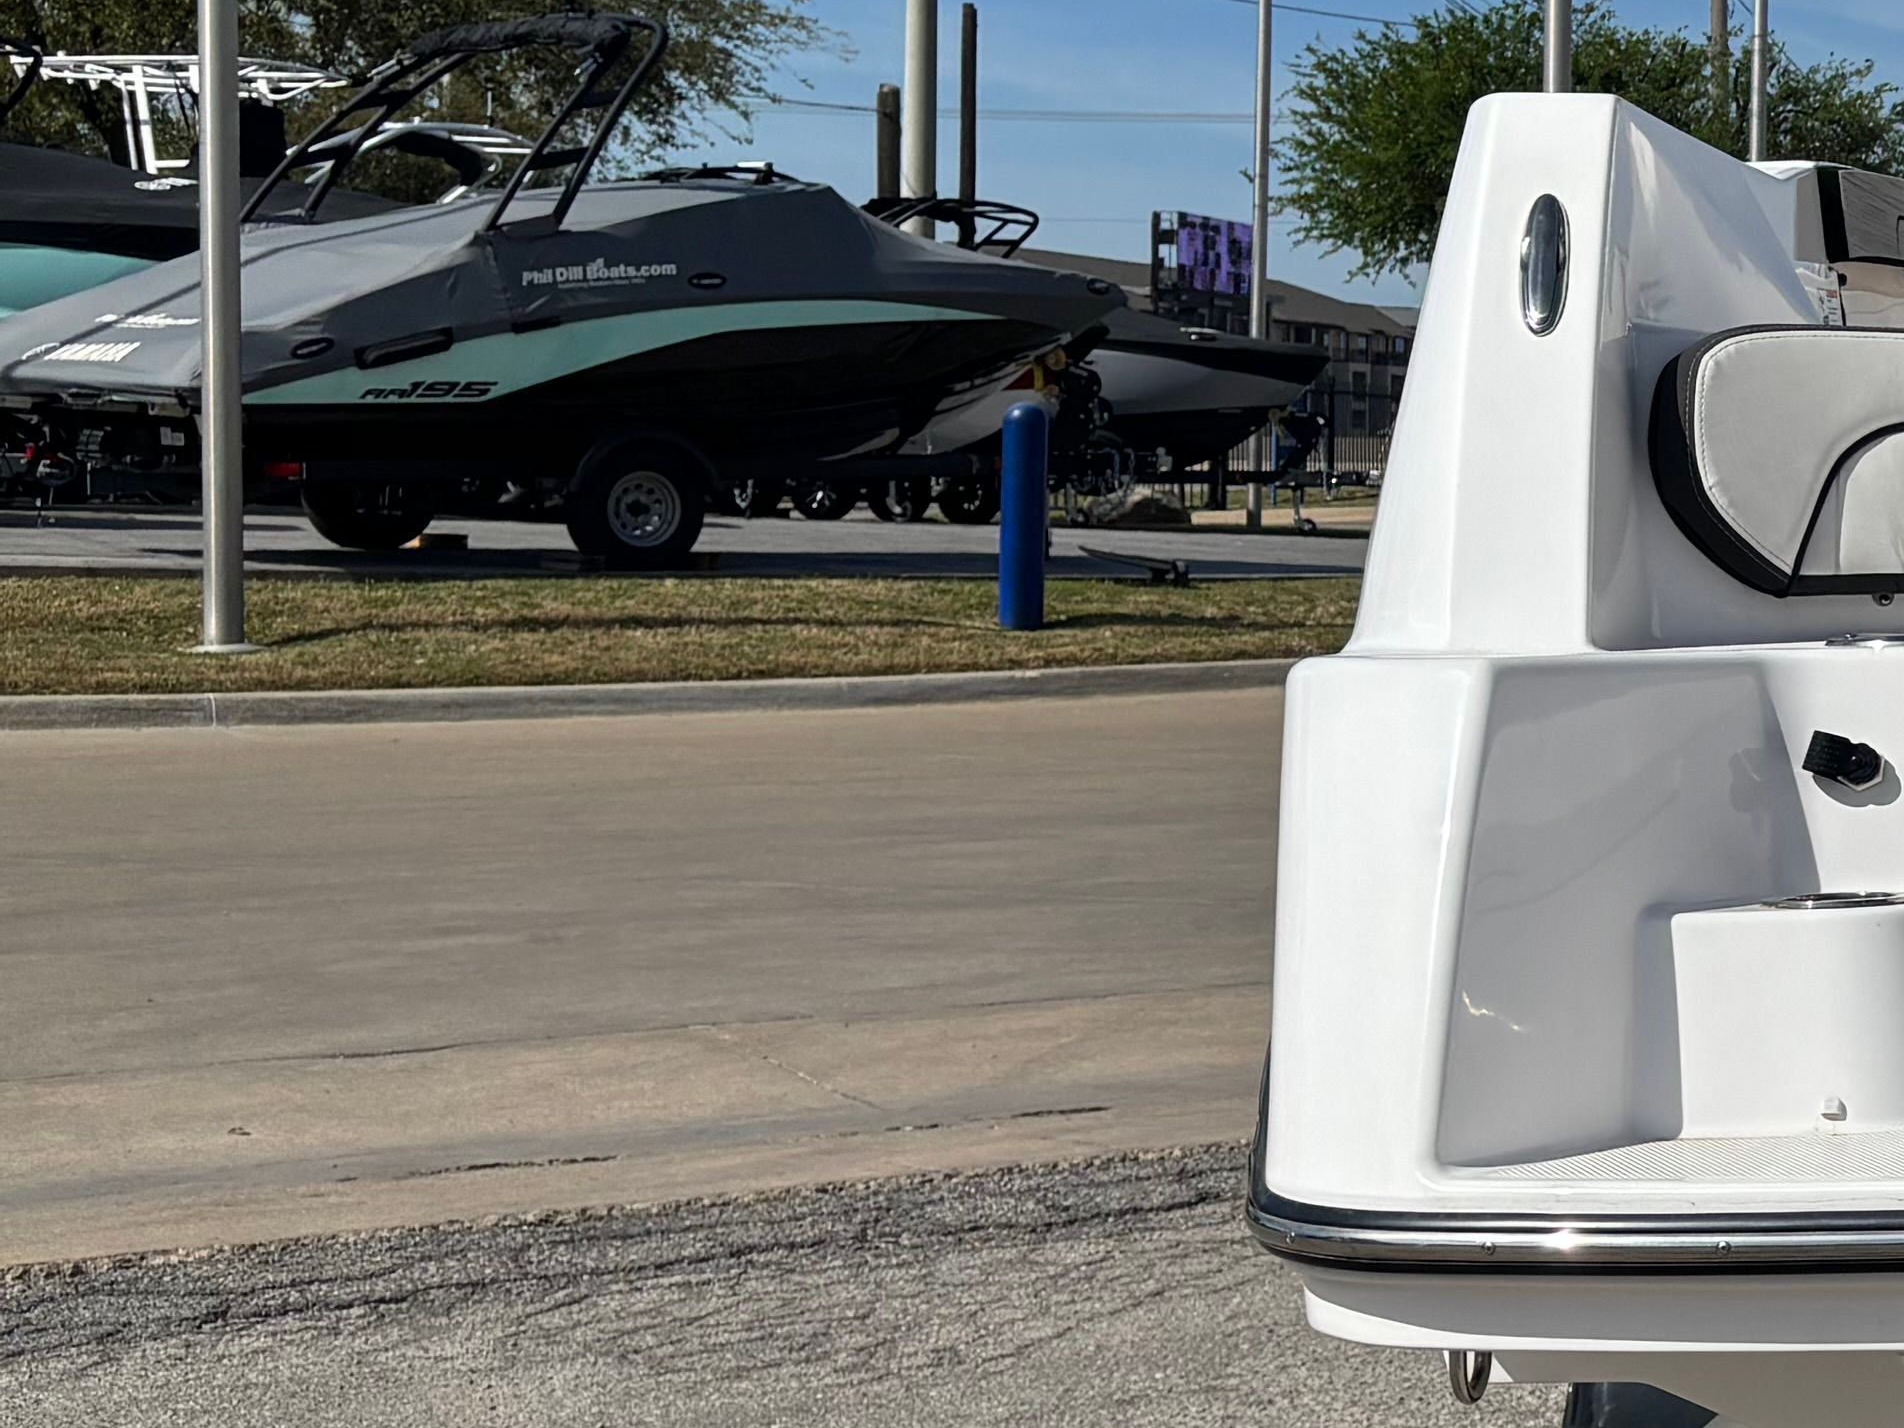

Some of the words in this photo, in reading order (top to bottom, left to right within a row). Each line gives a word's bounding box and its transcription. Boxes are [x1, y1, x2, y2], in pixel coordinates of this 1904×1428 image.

[522, 268, 553, 286] Phil
[555, 266, 584, 281] Dill
[586, 262, 677, 279] Boats.com
